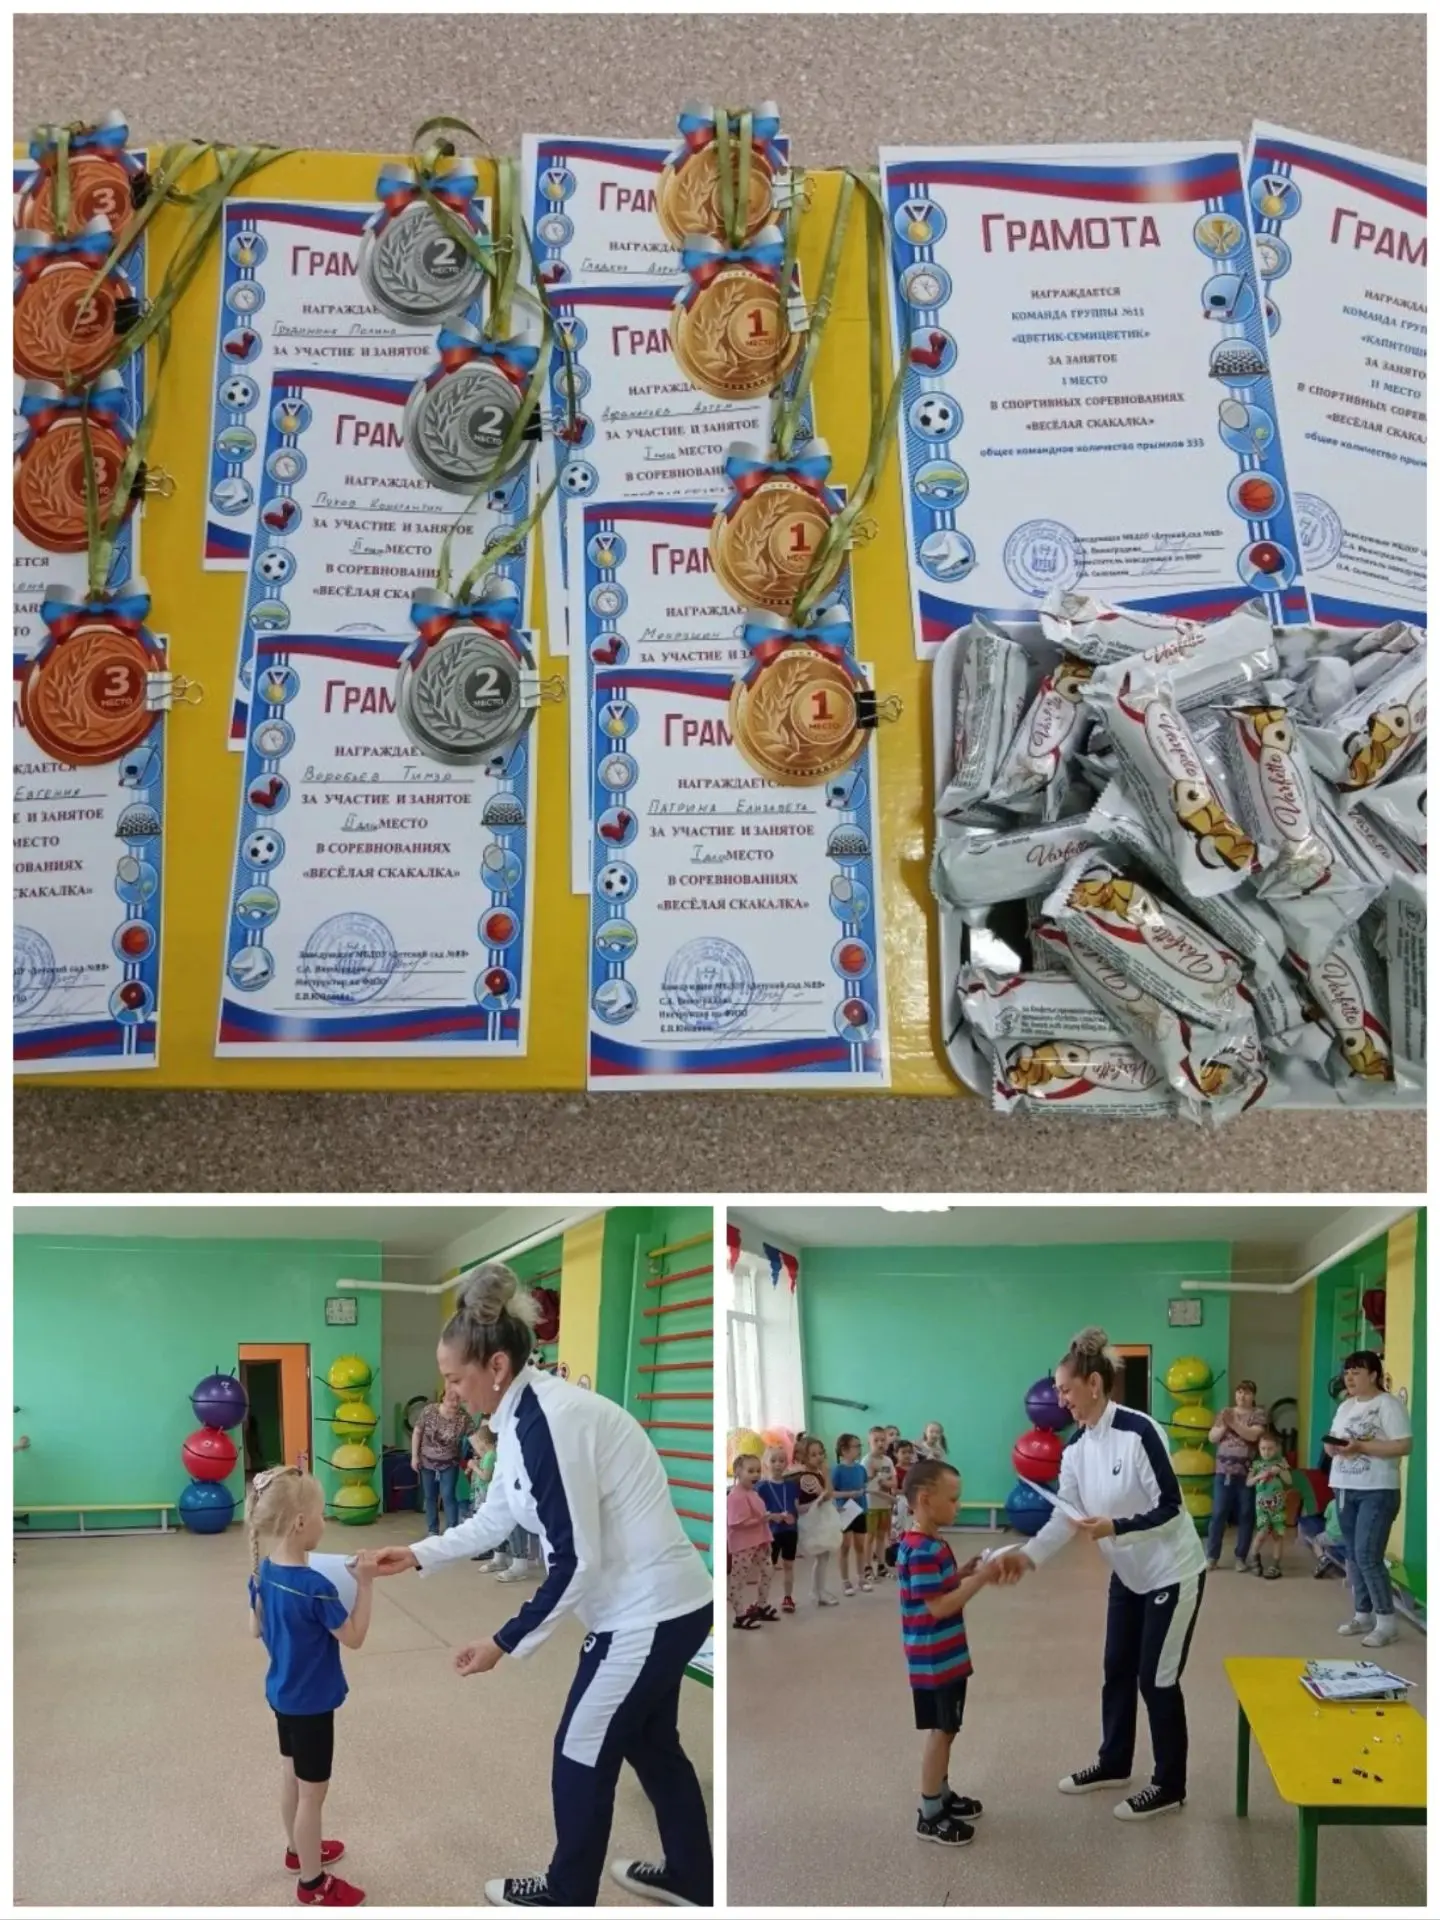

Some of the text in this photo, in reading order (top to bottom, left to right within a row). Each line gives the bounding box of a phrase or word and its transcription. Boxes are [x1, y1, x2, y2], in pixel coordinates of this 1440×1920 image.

[92, 187, 116, 214] 3
[981, 213, 1161, 253] ГРАМОТА
[1330, 207, 1427, 267] ГРАМ
[431, 237, 457, 265] 2
[291, 245, 360, 277] ГРАМ
[430, 265, 461, 275] МЕСТО
[1030, 286, 1121, 300] НАГРАЖДАЕТСЯ
[1363, 289, 1427, 313] НАГРАЖДА
[302, 303, 380, 316] НАГРАЖДАЕ
[1011, 306, 1145, 321] КОМАНДА ГРУППЫ №11
[747, 308, 769, 337] 1
[1342, 305, 1427, 335] КОМАНДА ГРУП
[1012, 329, 1150, 344] «ЦВЕТИК-СЕМИЦВЕТИК»
[273, 345, 431, 357] ЗА УЧАСТИЕ И ЗАНЯТОЕ
[1360, 334, 1427, 357] «КАПИТОШ
[1048, 353, 1118, 366] ЗА ЗАНЯТОЕ
[1365, 357, 1427, 380] ЗА ЗАНЯТО
[628, 382, 698, 396] НАГРАЖДА
[1069, 375, 1108, 386] МЕСТО
[1297, 382, 1305, 392] В
[1308, 384, 1388, 412] СПОРТИВНЫХ
[1383, 381, 1422, 399] МЕСТО
[990, 392, 1185, 411] В СПОРТИВНЫХ СОРЕВНОВАНИЯХ
[479, 405, 503, 436] 2
[1026, 416, 1155, 431] «ВЕСЁЛАЯ СКАКАЛКА»
[1325, 412, 1384, 433] «ВЕСЁЛАЯ
[335, 413, 405, 449] ГРАМ
[605, 419, 760, 441] ЗА УЧАСТИЕ И ЗАНЯТОЕ
[678, 444, 723, 457] МЕСТО
[980, 447, 1014, 459] общее
[1016, 444, 1074, 456] командное
[1076, 441, 1134, 454] количество
[1305, 431, 1339, 446] общее
[1340, 438, 1398, 461] количество
[626, 471, 634, 482] В
[312, 518, 475, 535] ЗА УЧАСТИЕ И ЗАНЯТОЕ
[789, 522, 812, 552] 1
[385, 543, 433, 556] МЕСТО
[325, 564, 335, 575] В
[640, 653, 655, 663] ЗА
[661, 651, 722, 663] УЧАСТИЕ
[728, 650, 738, 660] И
[104, 665, 130, 697] 3
[474, 667, 501, 698] 2
[101, 698, 133, 707] МЕСТО
[324, 680, 397, 714] ГРАМ
[811, 690, 834, 721] 1
[664, 713, 734, 747] ГРАМ
[808, 722, 841, 731] МЕСТО
[1273, 752, 1303, 827] Varfetto
[301, 794, 472, 805] ЗА УЧАСТИЕ И ЗАНЯТОЕ
[27, 808, 104, 823] И ЗАНЯТОЕ
[379, 818, 429, 829] МЕСТО
[649, 825, 815, 837] ЗА УЧАСТИЕ И ЗАНЯТОЕ
[316, 843, 451, 854] В СОРЕВНОВАНИЯХ
[725, 849, 774, 861] МЕСТО
[13, 860, 84, 874] ОВАНИЯХ
[302, 865, 461, 879] «ВЕСЁЛАЯ СКАКАЛКА»
[668, 874, 798, 886] В СОРЕВНОВАНИЯХ
[657, 897, 810, 911] «ВЕСЁЛАЯ СКАКАЛКА»
[1321, 961, 1362, 1025] Varfetto
